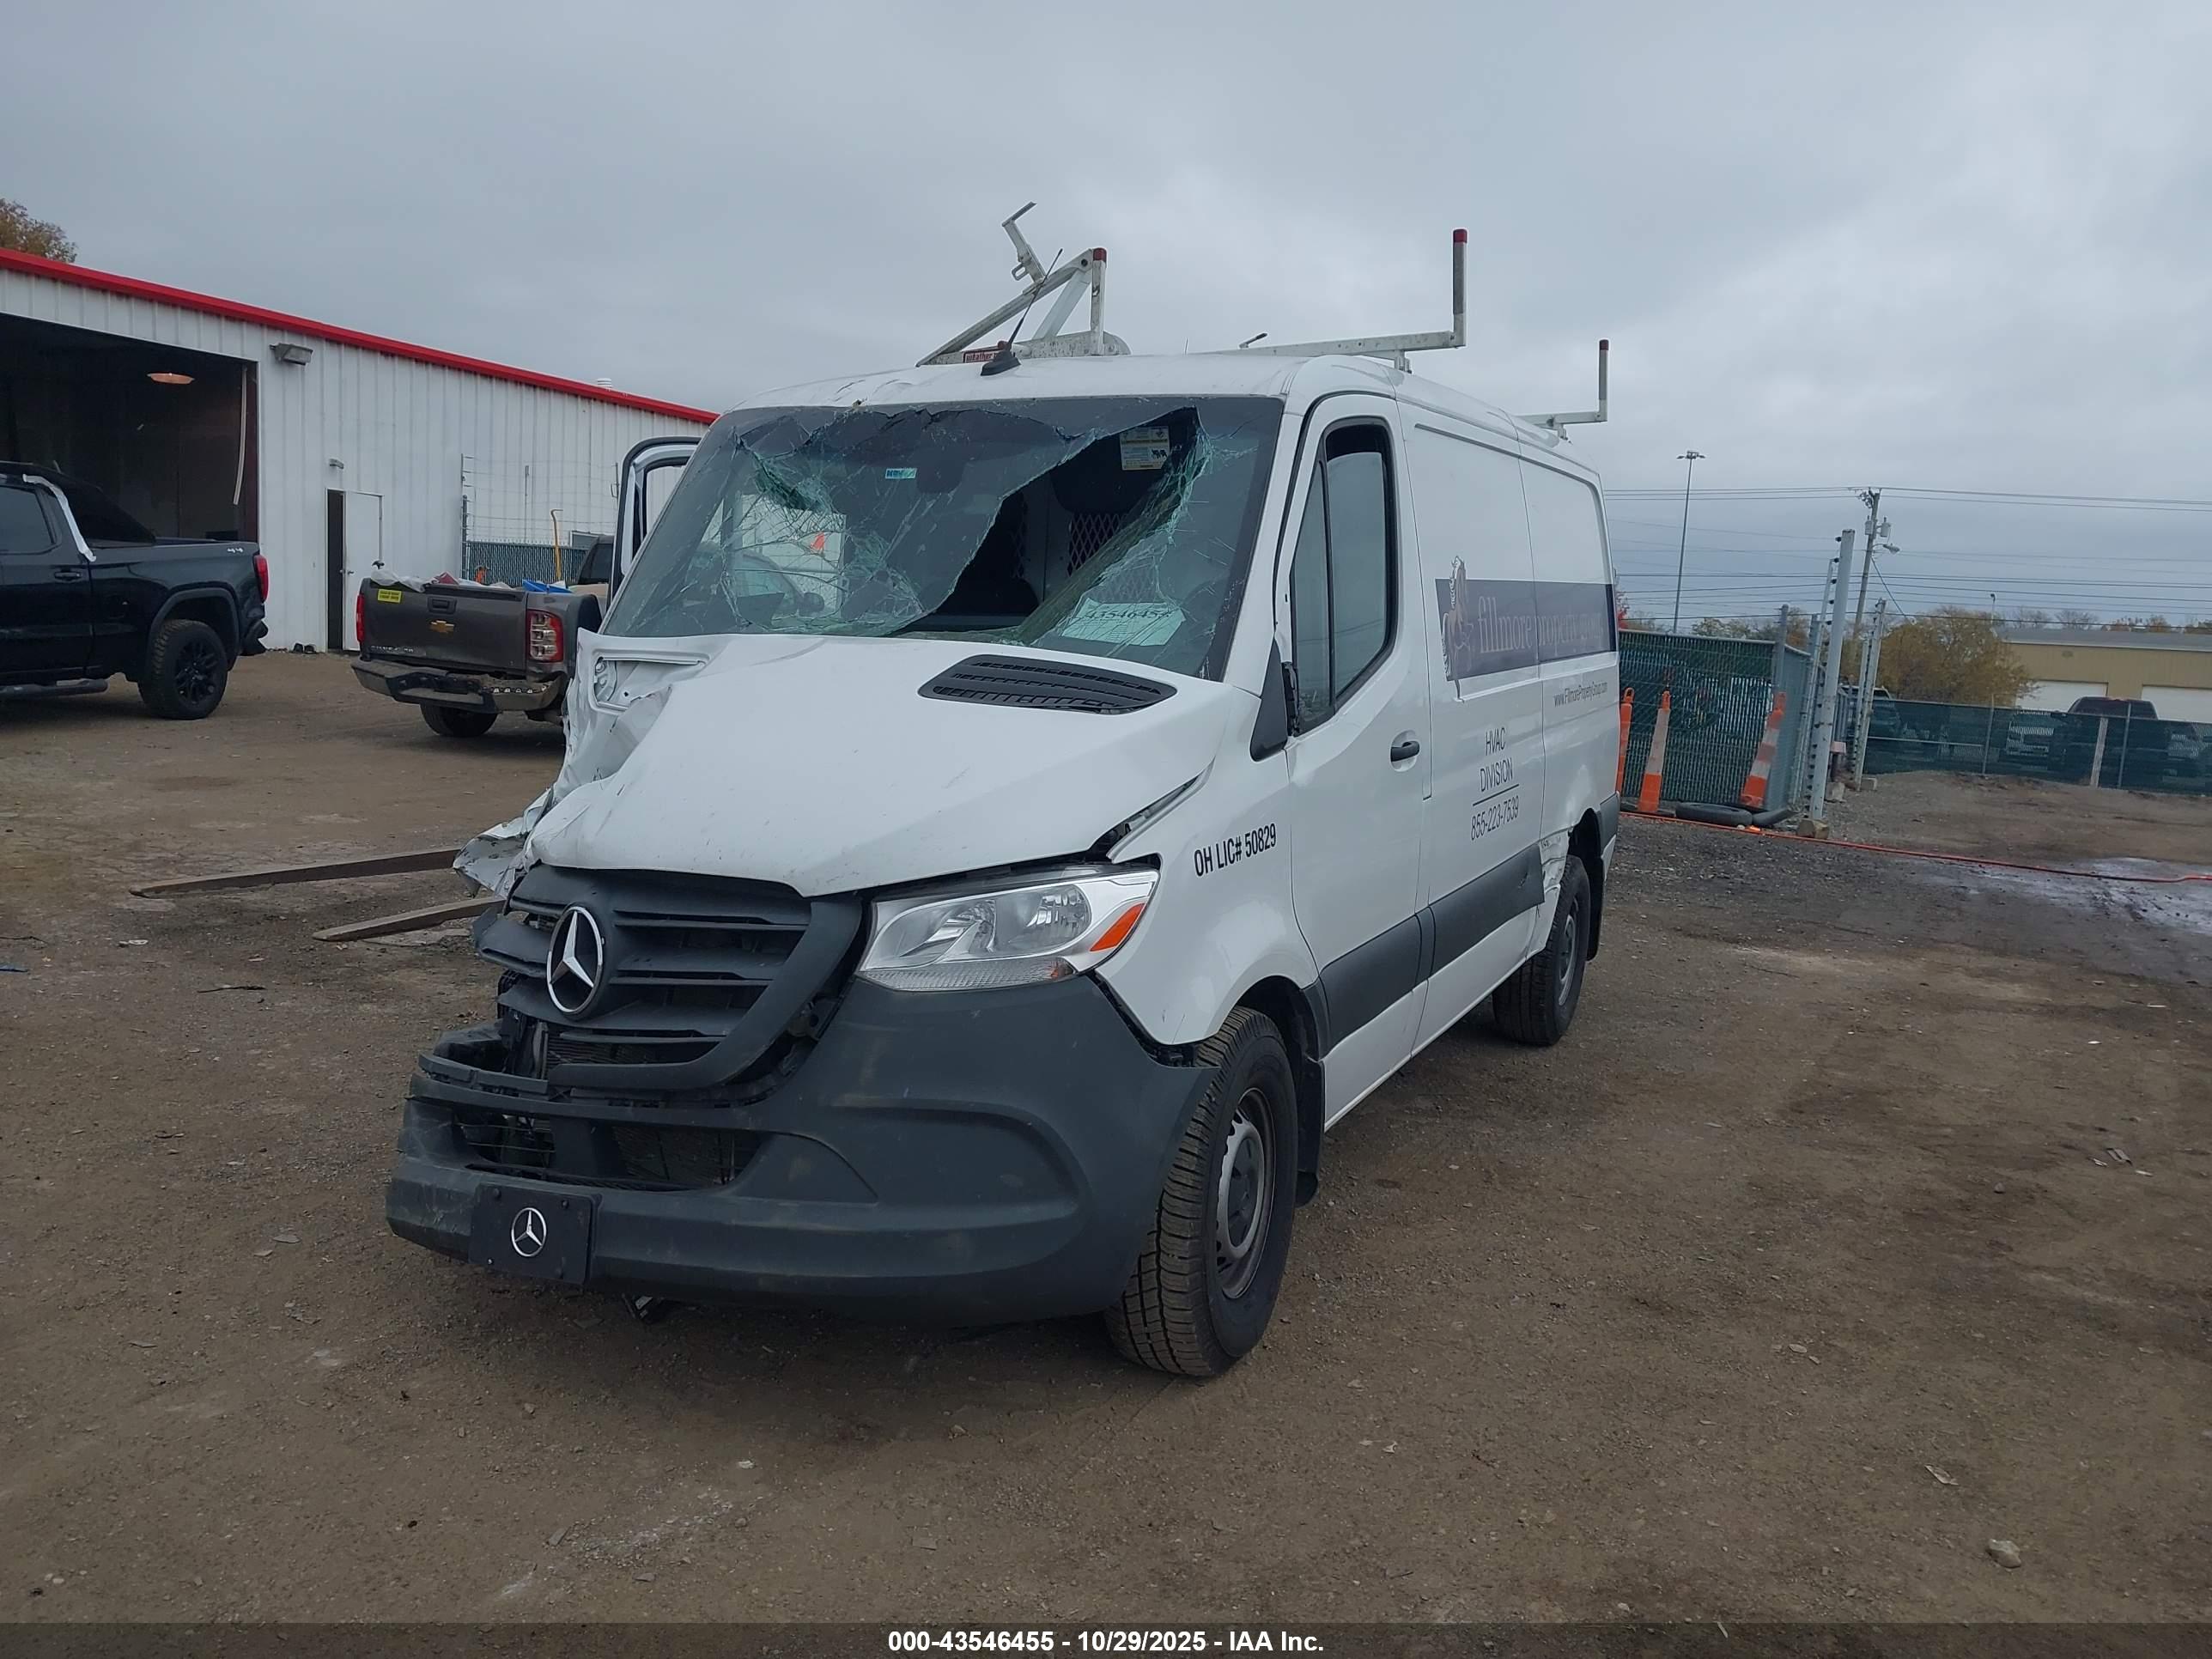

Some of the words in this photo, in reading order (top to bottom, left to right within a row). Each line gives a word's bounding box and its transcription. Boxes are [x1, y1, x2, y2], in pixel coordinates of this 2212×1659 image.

[1478, 596, 1533, 653] fillmore
[1486, 727, 1505, 756] HVAC
[1480, 757, 1513, 792] DIVISION
[1471, 795, 1519, 841] 855-223-7539
[1194, 846, 1213, 877] OH
[1216, 836, 1243, 869] LIC#
[1244, 823, 1276, 858] 50829
